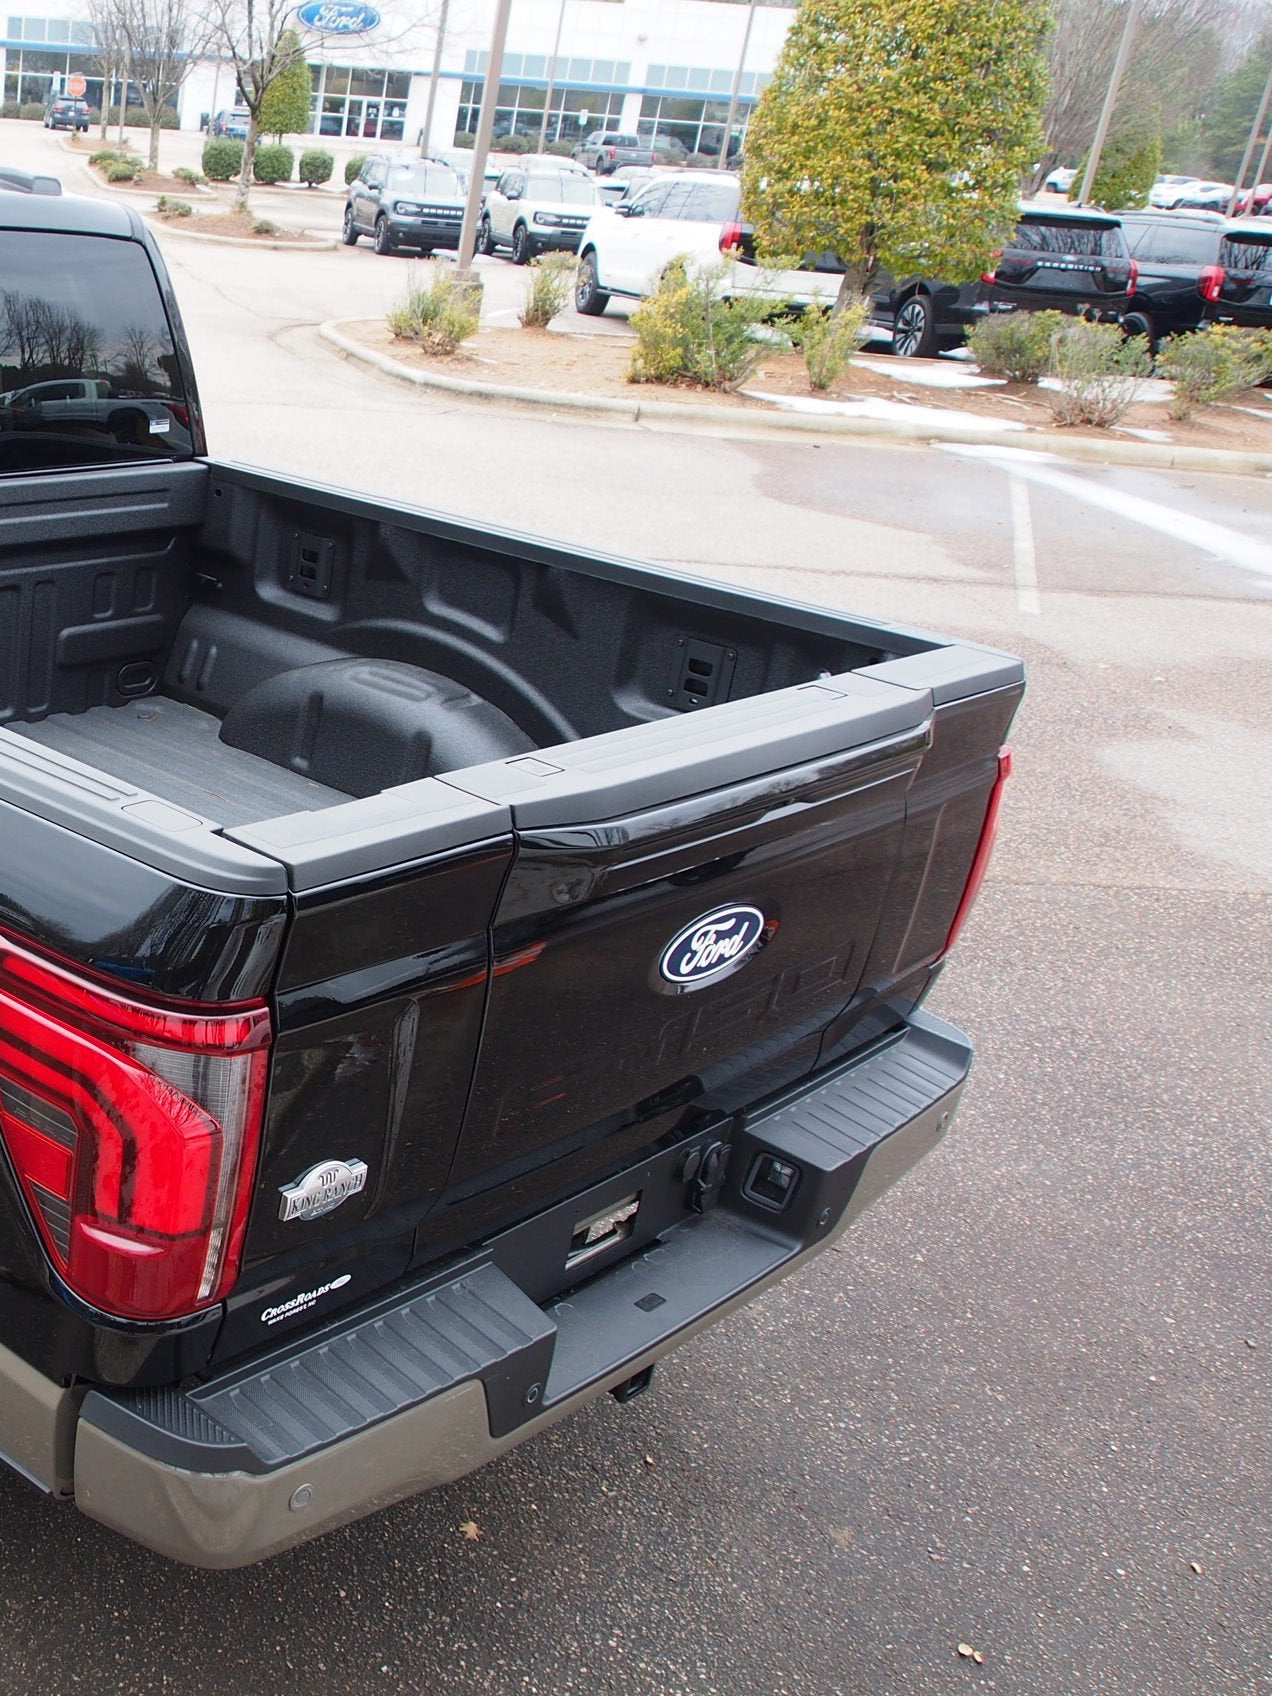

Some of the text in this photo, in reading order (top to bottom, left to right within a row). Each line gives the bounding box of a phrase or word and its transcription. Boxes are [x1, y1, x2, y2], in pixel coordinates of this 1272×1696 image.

[313, 5, 365, 29] Ford
[679, 917, 750, 975] Ford
[292, 1191, 321, 1214] KING
[323, 1172, 363, 1200] RANCH
